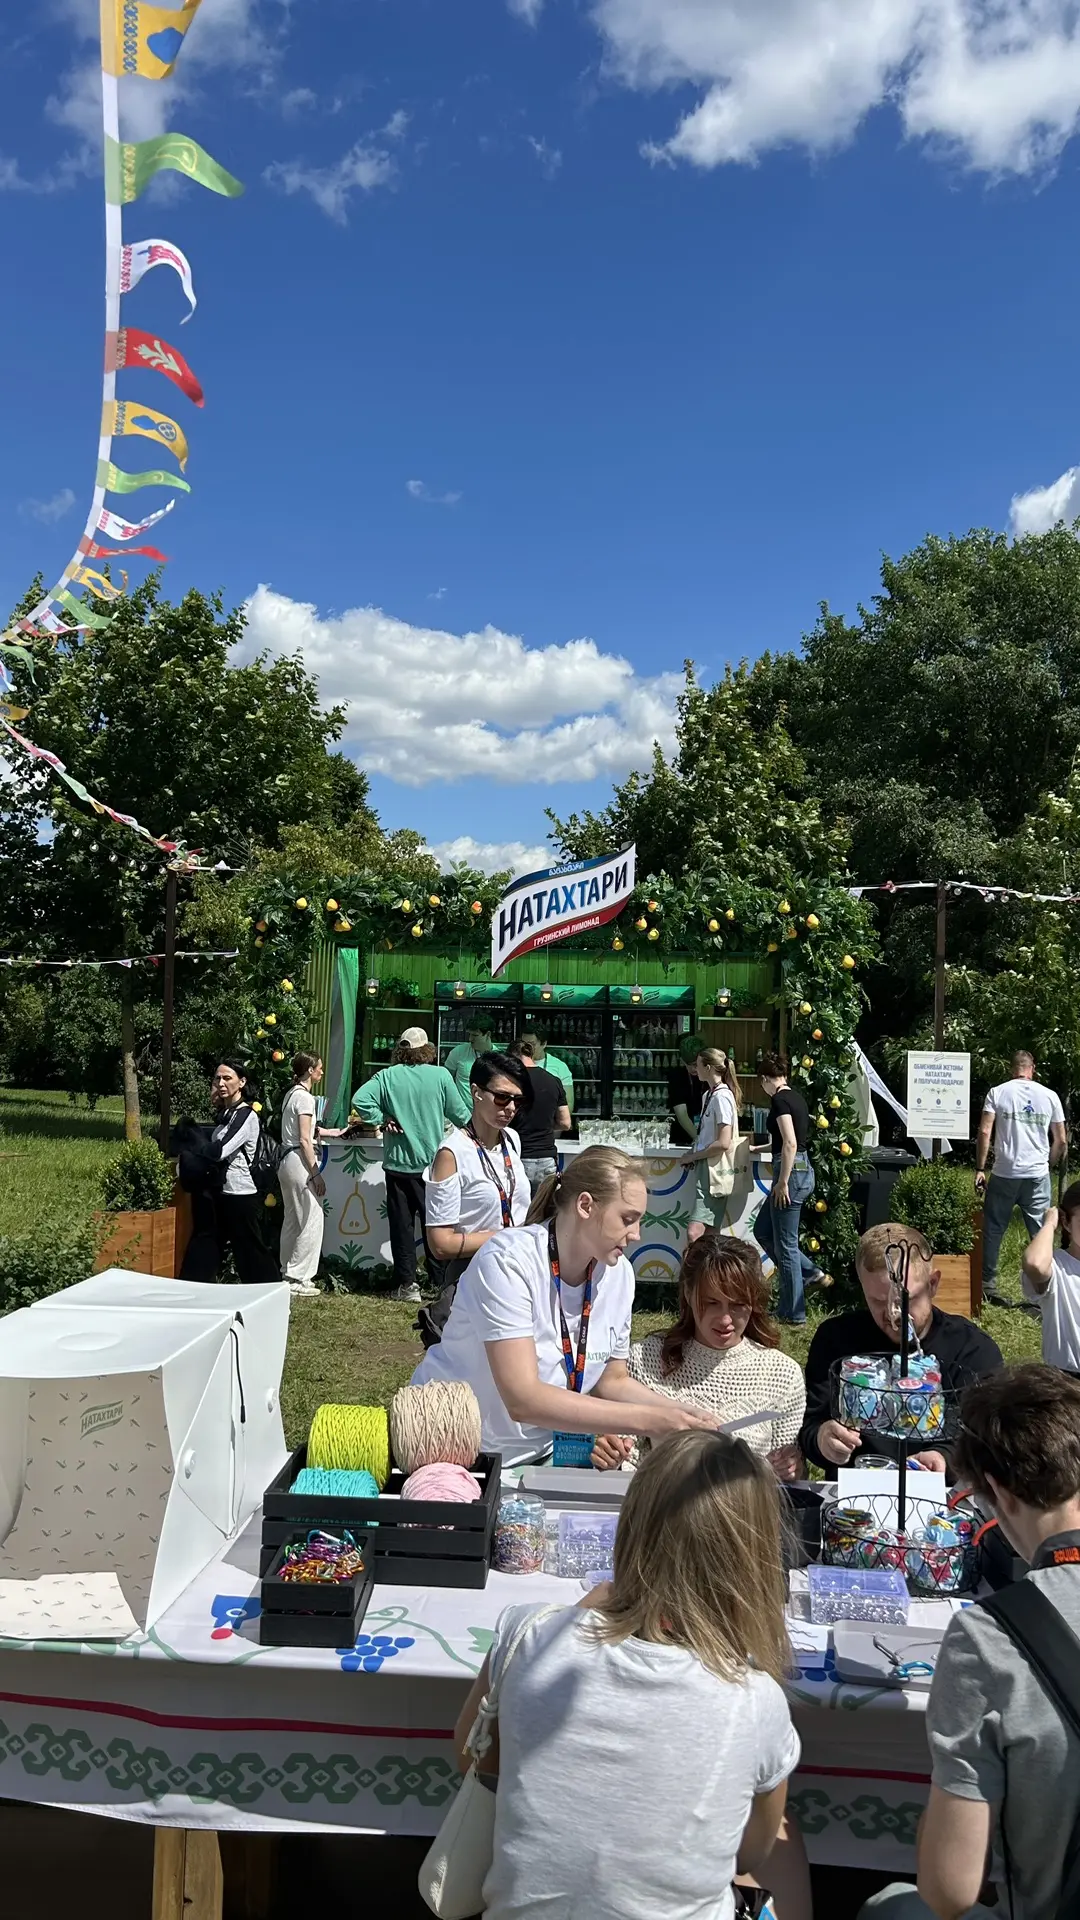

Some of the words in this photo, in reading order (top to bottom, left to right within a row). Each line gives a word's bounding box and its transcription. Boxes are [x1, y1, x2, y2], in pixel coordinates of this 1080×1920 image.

[499, 861, 628, 951] НАТАХТАРИ
[533, 926, 571, 946] ГРУЗИНСКИЙ
[571, 916, 600, 934] ЛИМОНАД
[81, 1404, 123, 1433] НАТАХТАРИ
